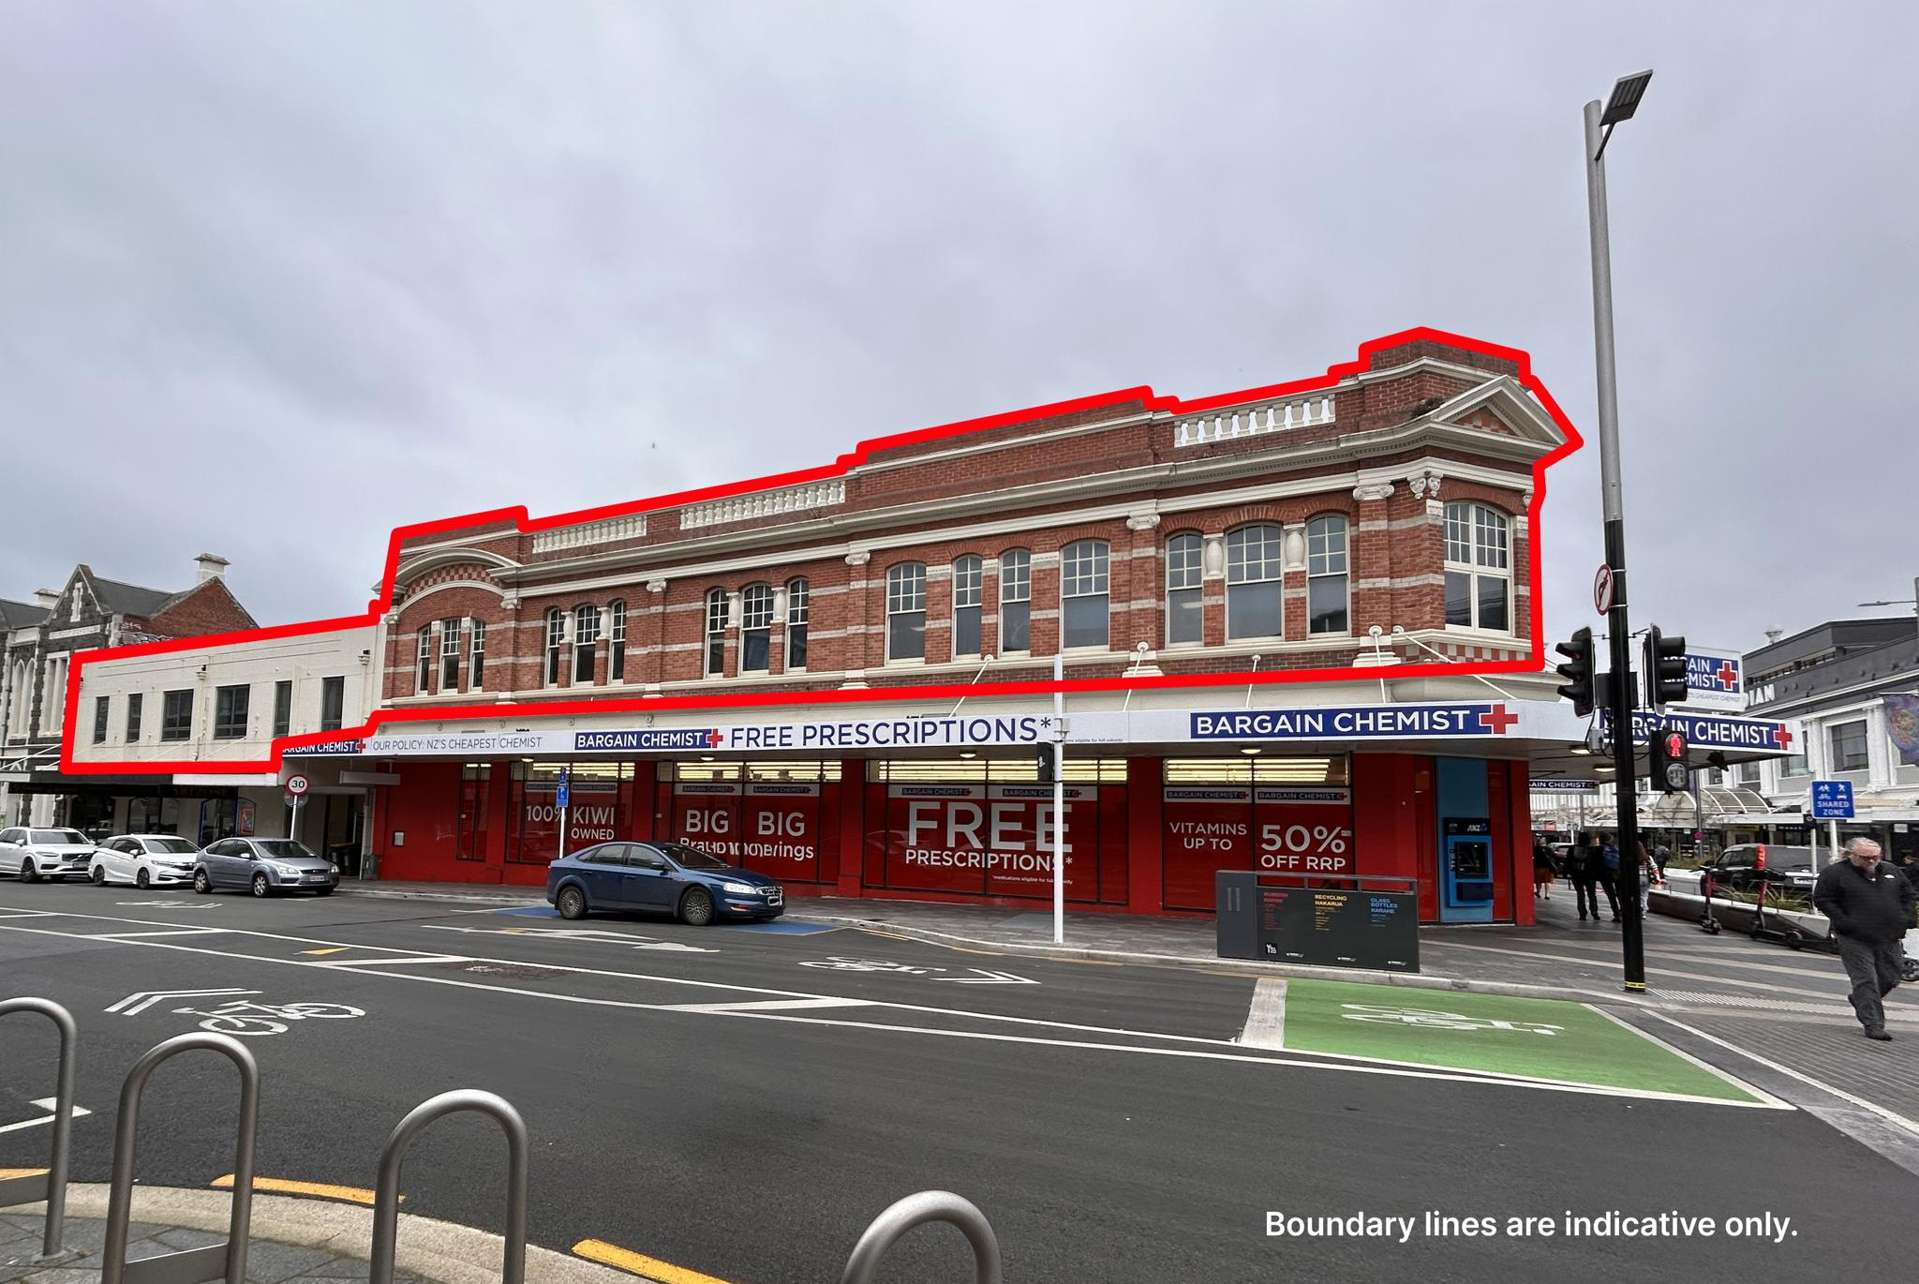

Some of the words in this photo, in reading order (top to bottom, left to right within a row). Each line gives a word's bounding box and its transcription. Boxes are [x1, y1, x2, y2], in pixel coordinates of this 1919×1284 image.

[1196, 713, 1324, 735] BARGAIN
[1333, 710, 1470, 732] CHEMIST
[576, 733, 640, 749] BARGAIN
[641, 731, 703, 747] CHEMIST
[730, 725, 793, 748] FREE
[1694, 721, 1770, 745] CHEMIST
[317, 741, 355, 753] CHEMIST
[372, 741, 391, 751] OUR
[392, 740, 423, 751] POLICY:
[426, 739, 447, 750] NZ'S
[448, 737, 497, 750] CHEAPEST
[498, 736, 543, 749] CHEMIST
[292, 780, 305, 789] 30
[1167, 791, 1203, 799] BARGAIN
[1203, 792, 1240, 800] CHEMIST
[1258, 792, 1296, 800] BARGAIN
[1297, 793, 1338, 801] CHEMIST
[1817, 801, 1850, 809] SHARED
[1823, 808, 1845, 816] ZONE
[572, 806, 615, 826] KIWI
[685, 810, 729, 834] BIG
[757, 811, 805, 837] BIG
[571, 828, 615, 841] OWNED
[908, 801, 1073, 853] FREE
[1169, 821, 1248, 836] VITAMINS
[1183, 837, 1206, 850] UP
[1208, 838, 1233, 851] TO
[1261, 824, 1346, 854] 50%
[905, 849, 1073, 872] PRESCRIPTION
[1260, 855, 1303, 870] OFF
[1306, 856, 1346, 872] RRP
[1314, 894, 1348, 902] RECYCLING
